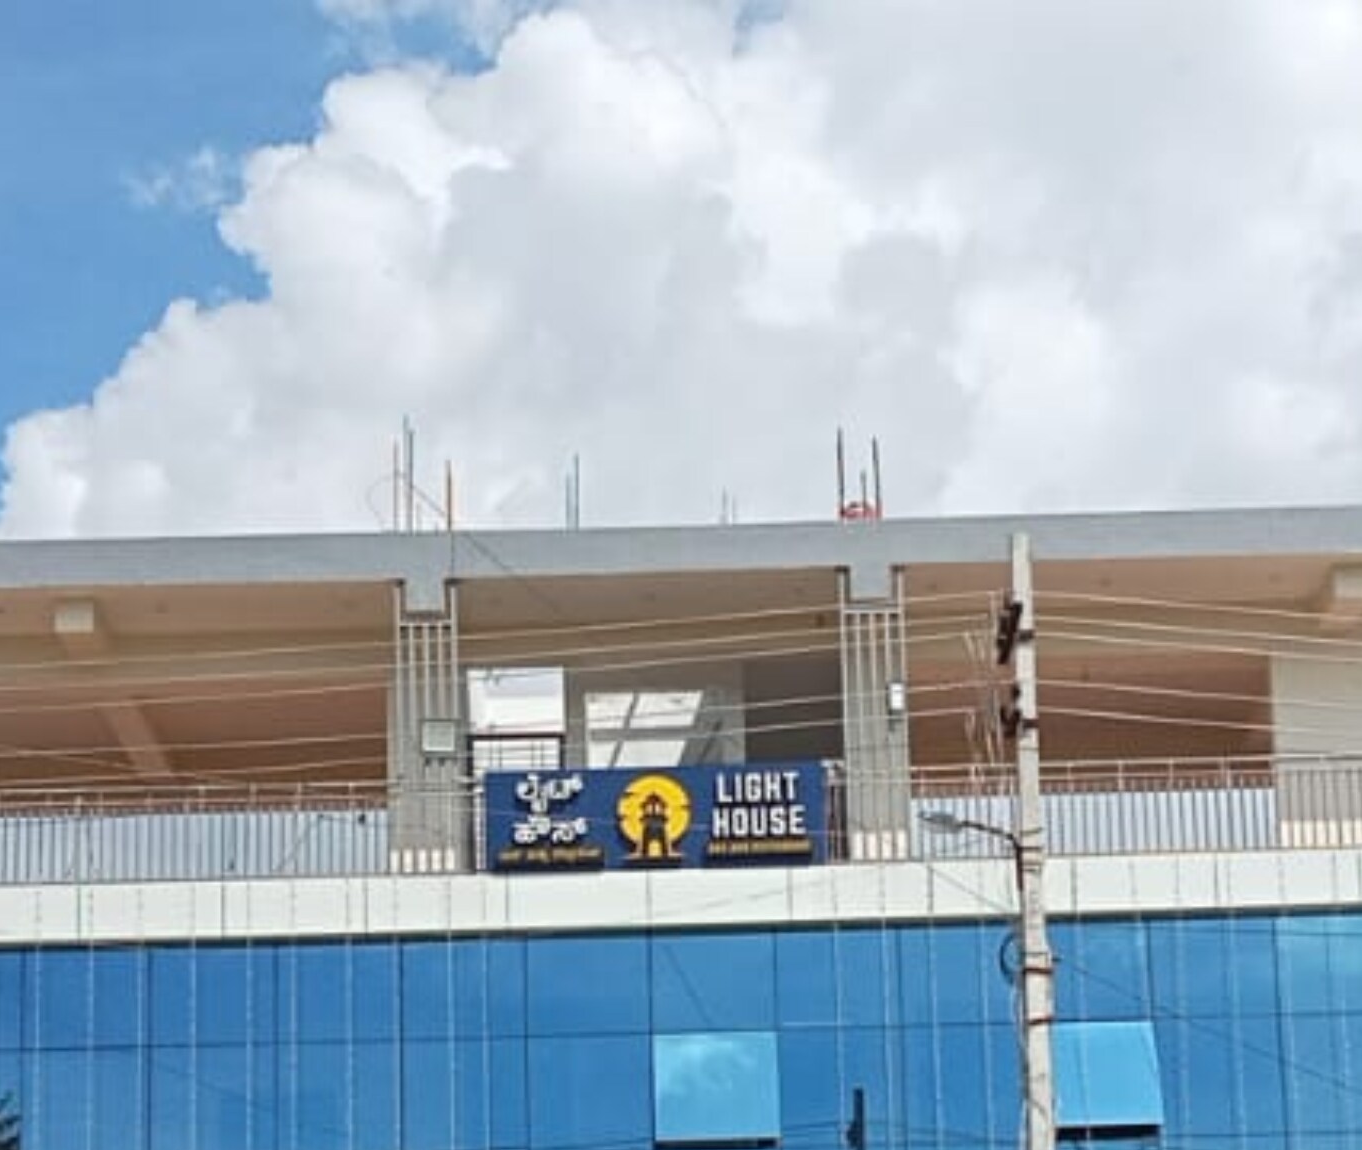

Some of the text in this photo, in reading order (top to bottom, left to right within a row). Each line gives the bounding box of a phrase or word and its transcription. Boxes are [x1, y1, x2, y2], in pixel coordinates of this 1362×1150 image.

[516, 773, 583, 813] ಲೈಟ್
[717, 770, 799, 803] LIGHT
[512, 815, 587, 843] ಹೌಸ್
[712, 804, 807, 837] HOUSE
